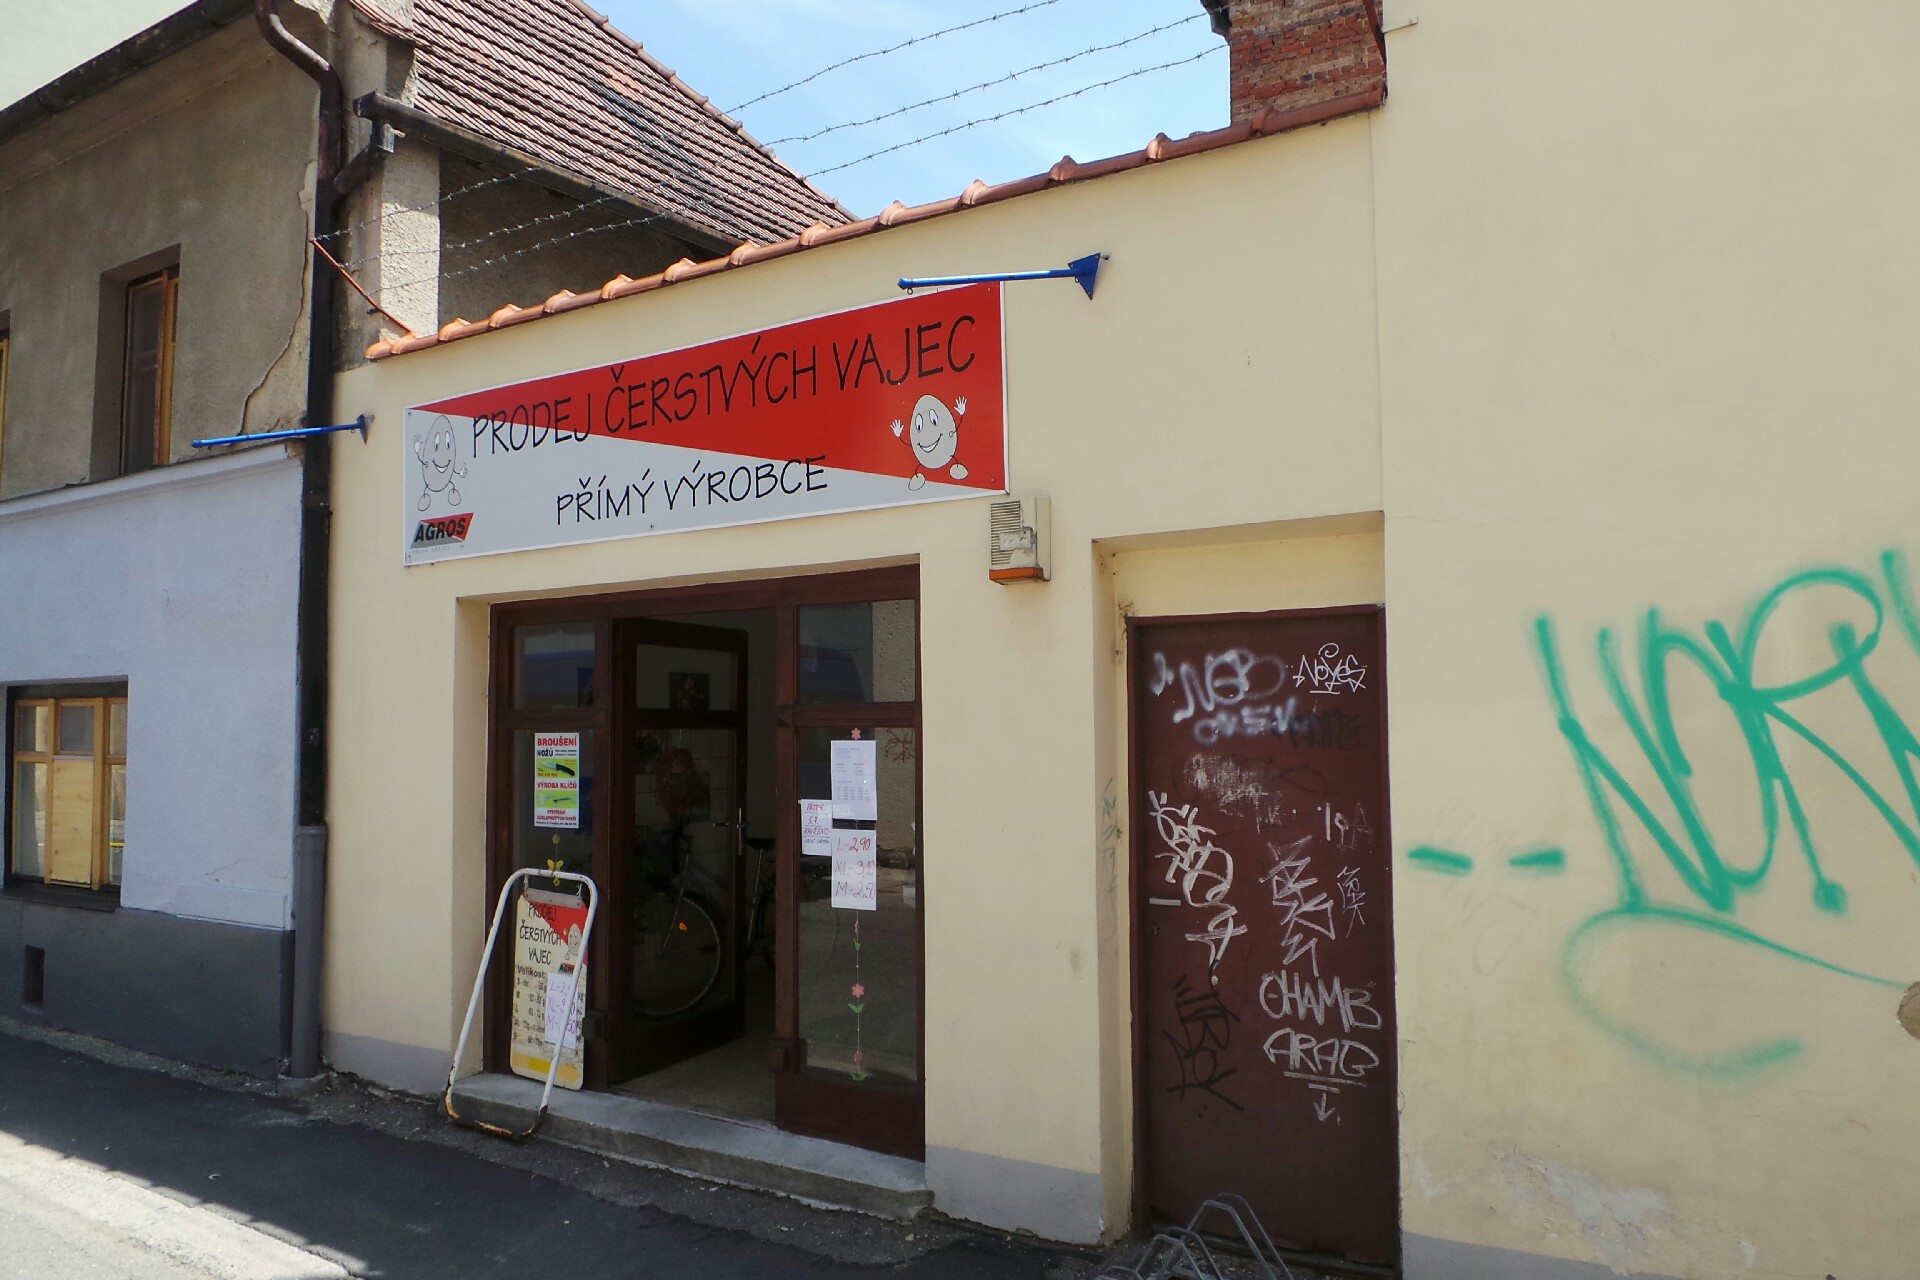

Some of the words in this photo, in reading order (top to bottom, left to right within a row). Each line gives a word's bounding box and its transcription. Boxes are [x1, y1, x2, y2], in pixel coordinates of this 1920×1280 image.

[473, 392, 591, 458] PRODEJ
[604, 335, 817, 434] ČERSTVÝCH
[832, 315, 976, 391] VAJEC
[556, 468, 654, 525] PŘÍMÝ
[664, 455, 828, 511] VÝROBCE
[414, 517, 466, 542] AGROS
[537, 735, 577, 747] BROUŠENÍ
[537, 747, 554, 757] NOŽŮ
[537, 781, 559, 789] VÝROBA
[559, 779, 578, 790] KLÍČŮ
[527, 902, 557, 922] PRODEJ
[519, 918, 562, 946] ČERSTVÝCH
[528, 946, 552, 966] VAJEC
